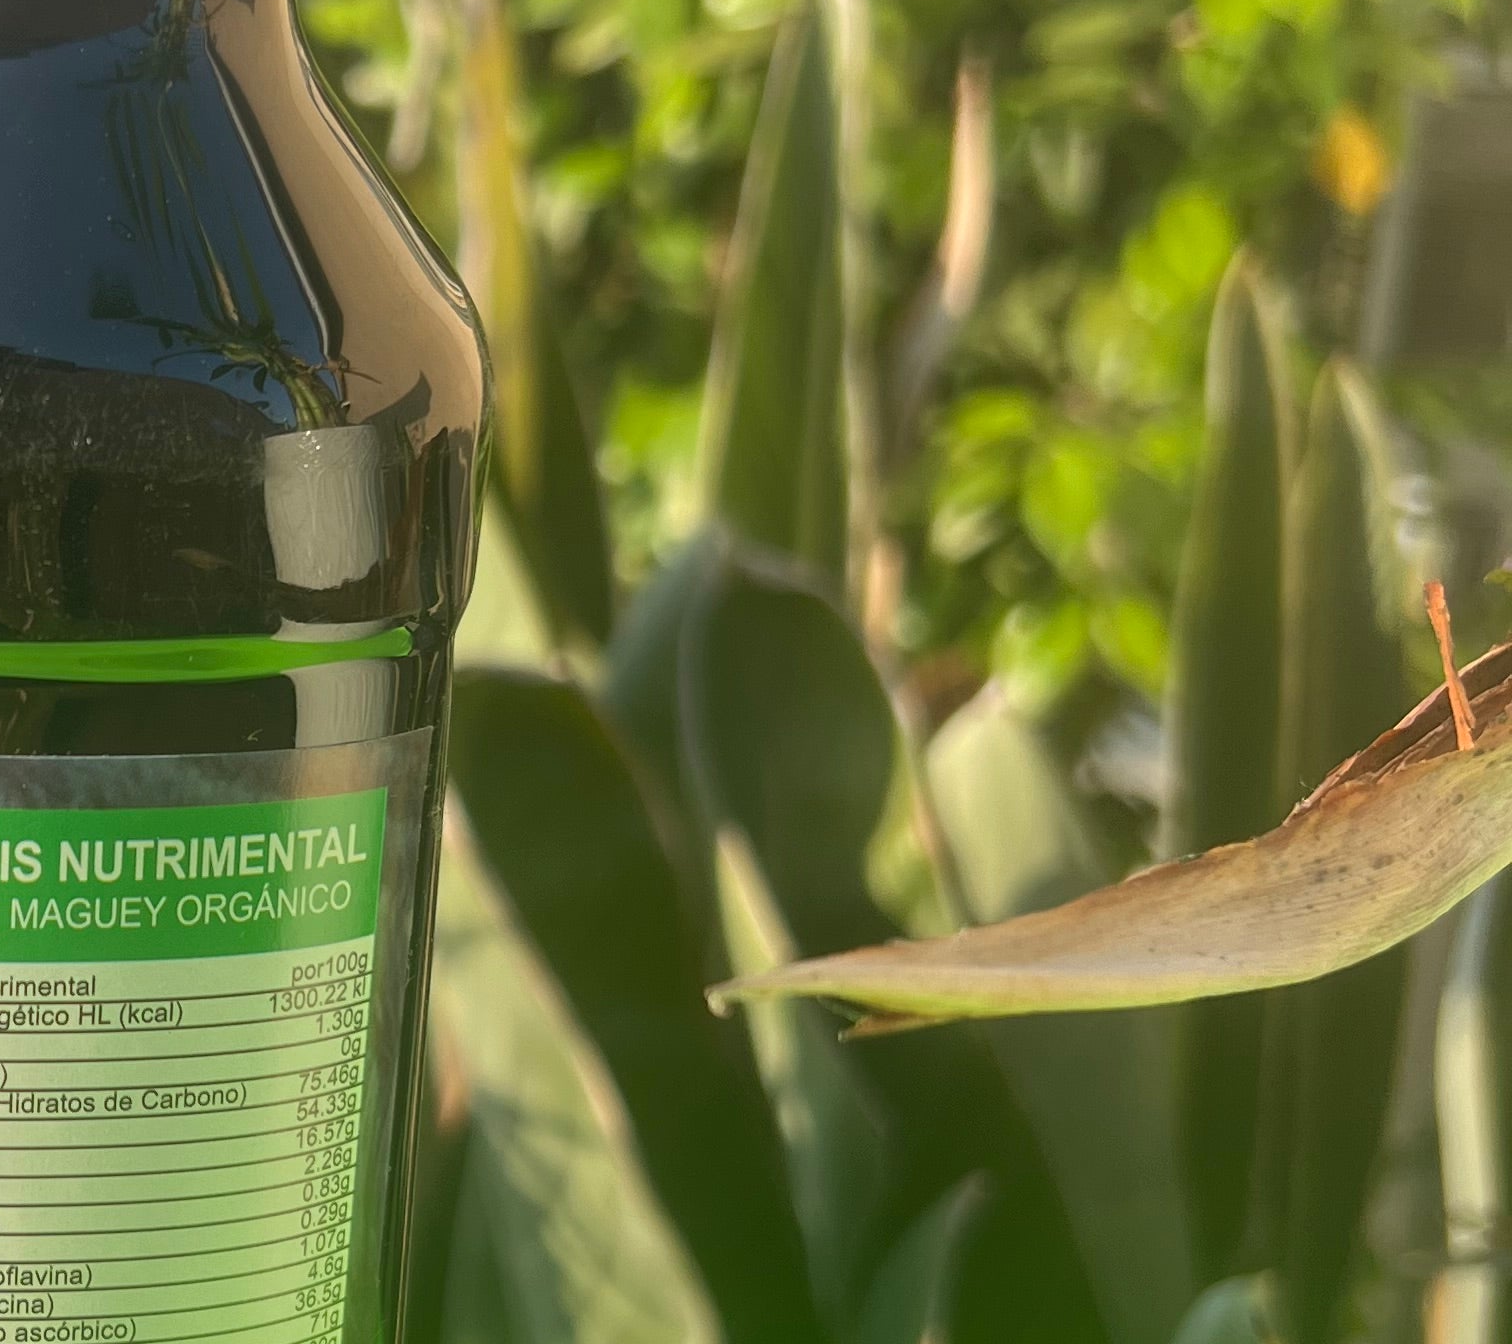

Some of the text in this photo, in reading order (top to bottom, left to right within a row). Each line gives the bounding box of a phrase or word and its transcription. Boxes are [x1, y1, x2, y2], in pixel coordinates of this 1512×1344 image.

[59, 823, 367, 883] NUTRIMENTAL
[10, 896, 167, 929] MAGUEY
[176, 879, 352, 926] ORGÁNICO
[291, 951, 369, 987] por100g
[269, 983, 348, 1014] 1300.22
[78, 1002, 111, 1026] HL
[119, 1001, 183, 1030] (kcal)
[315, 1008, 363, 1035] 1.30g
[341, 1035, 361, 1056] 0g
[299, 1063, 360, 1094] 75.46g
[104, 1090, 133, 1112] de
[141, 1082, 248, 1109] Carbono)
[296, 1091, 357, 1122] 54.33g
[296, 1119, 354, 1149] 16.57g
[304, 1146, 352, 1175] 2.26g
[302, 1174, 350, 1202] 0.83g
[301, 1201, 348, 1229] 0.29g
[300, 1228, 346, 1256] 1.07g
[308, 1256, 344, 1280] 4.6g
[295, 1282, 342, 1312] 36.5g
[14, 1317, 136, 1343] ascórbico)
[310, 1310, 339, 1333] 71g
